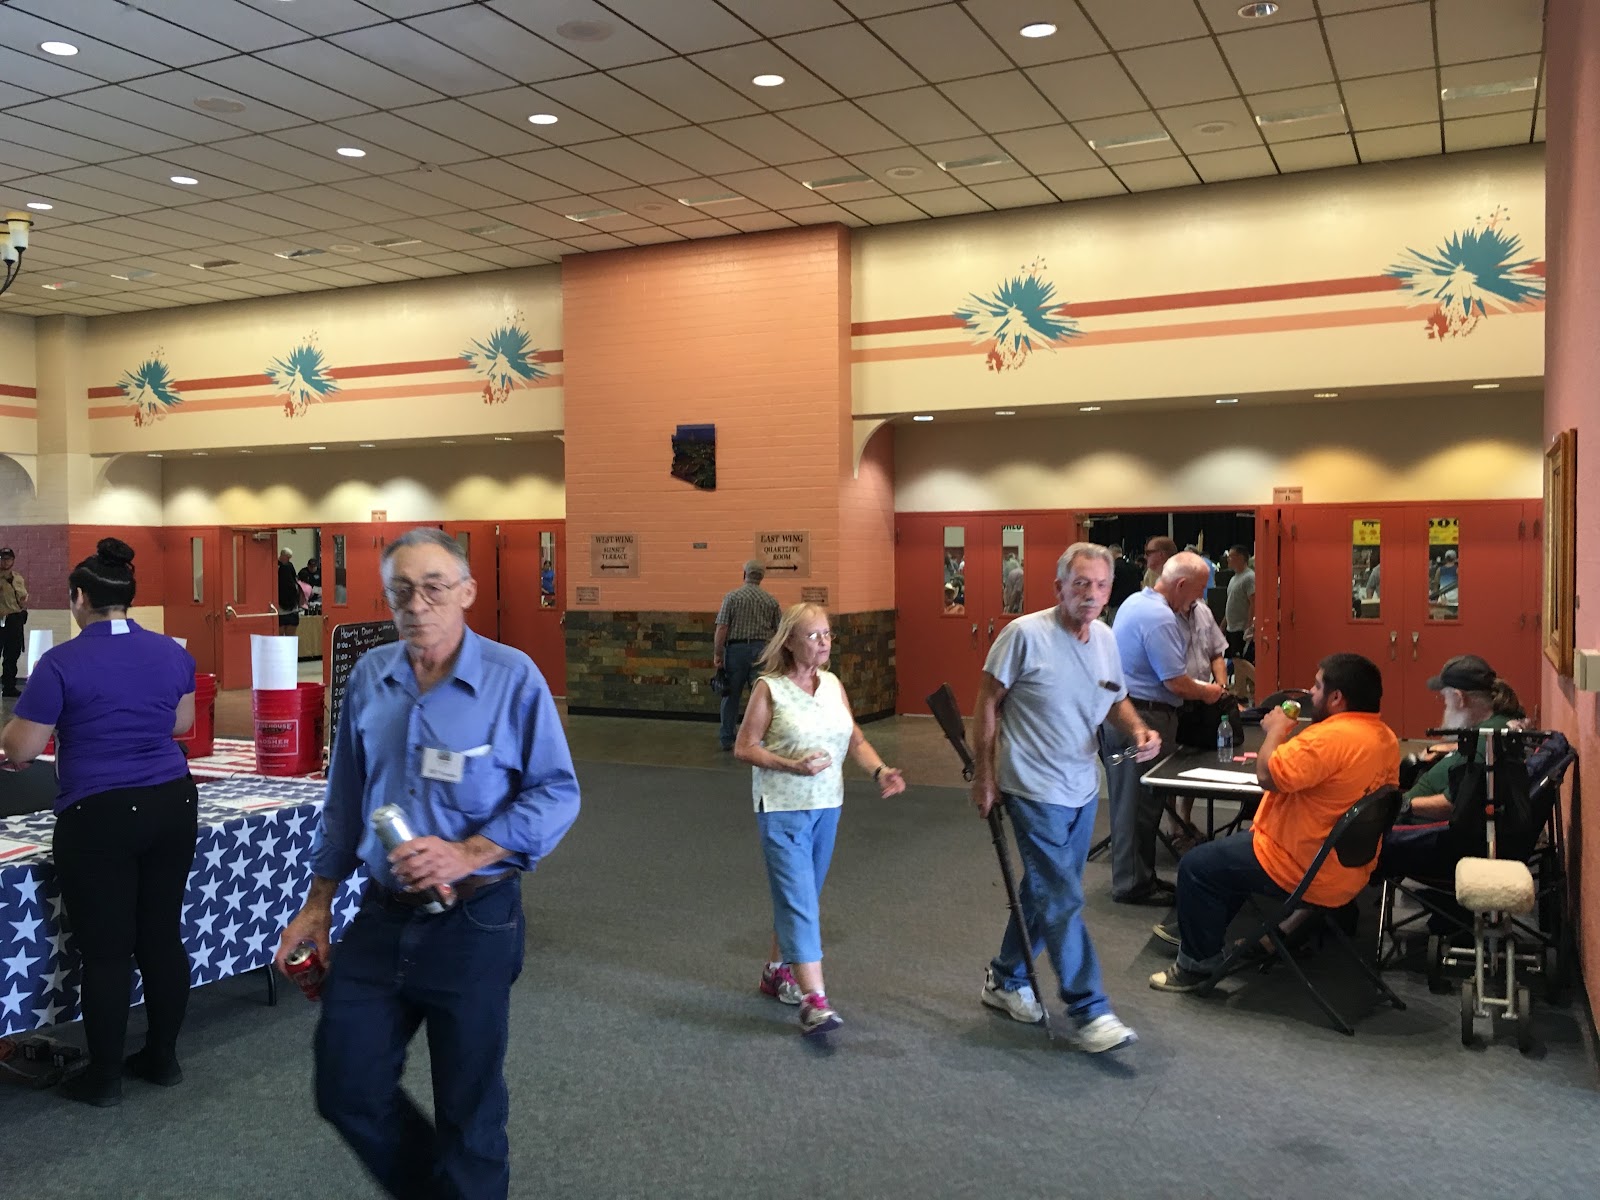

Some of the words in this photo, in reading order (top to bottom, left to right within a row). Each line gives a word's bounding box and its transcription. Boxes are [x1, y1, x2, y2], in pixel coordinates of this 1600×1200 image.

[595, 535, 614, 544] WEST
[615, 535, 634, 544] WING
[760, 533, 780, 543] EAST
[782, 533, 804, 543] WING
